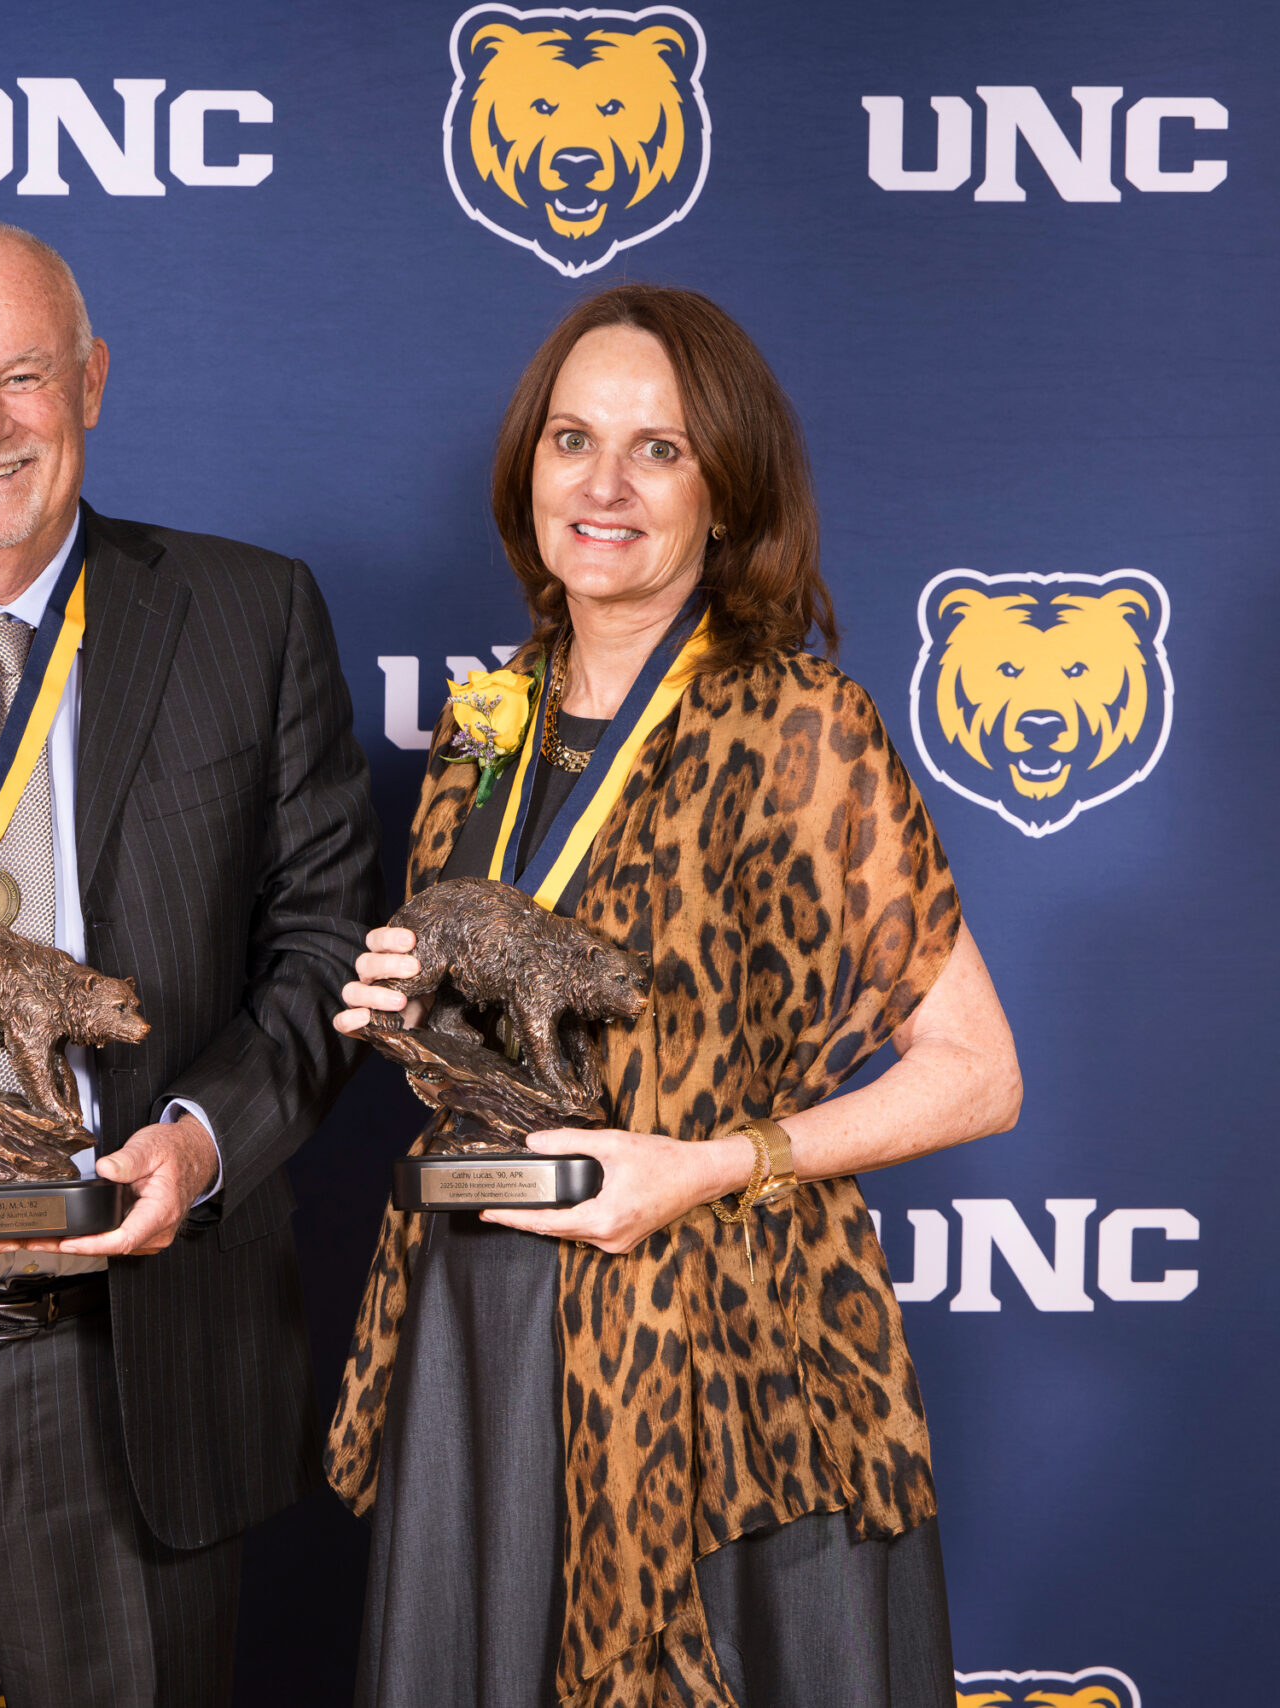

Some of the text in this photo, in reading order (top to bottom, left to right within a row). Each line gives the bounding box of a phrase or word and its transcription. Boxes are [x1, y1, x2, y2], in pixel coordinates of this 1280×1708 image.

[861, 86, 1229, 204] UNC
[451, 1171, 471, 1179] Cathy
[470, 1181, 495, 1189] Honored
[496, 1181, 517, 1189] Alumni
[449, 1191, 473, 1199] University
[28, 1210, 48, 1218] Award
